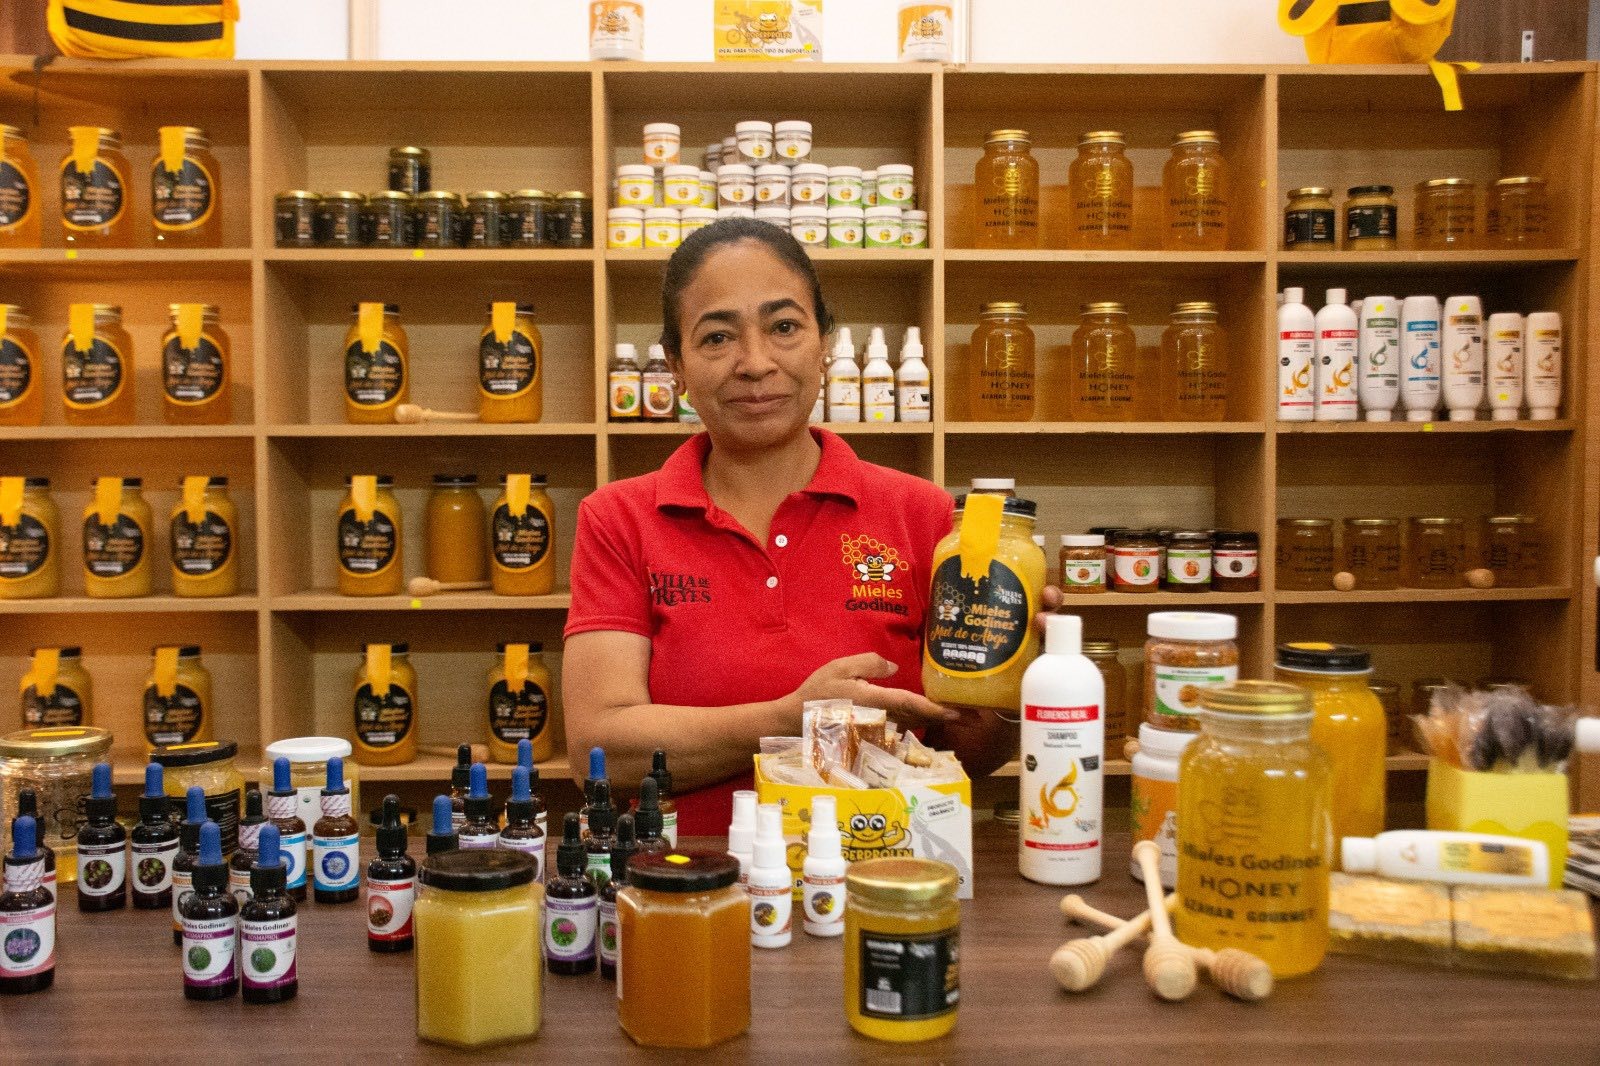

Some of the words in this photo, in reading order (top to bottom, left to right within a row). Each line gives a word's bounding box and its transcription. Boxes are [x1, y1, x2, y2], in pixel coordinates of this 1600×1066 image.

[993, 207, 1034, 217] HONEY
[990, 381, 1031, 390] HONEY
[1088, 383, 1130, 393] HONEY
[651, 572, 695, 588] VILLA
[655, 588, 711, 607] REYES
[852, 583, 903, 599] Mieles
[845, 598, 909, 616] Godinez
[971, 603, 1012, 619] Mieles
[964, 614, 1015, 631] Godinez
[1200, 874, 1298, 899] HONEY
[199, 921, 226, 930] Godinez
[262, 921, 290, 931] Godinez
